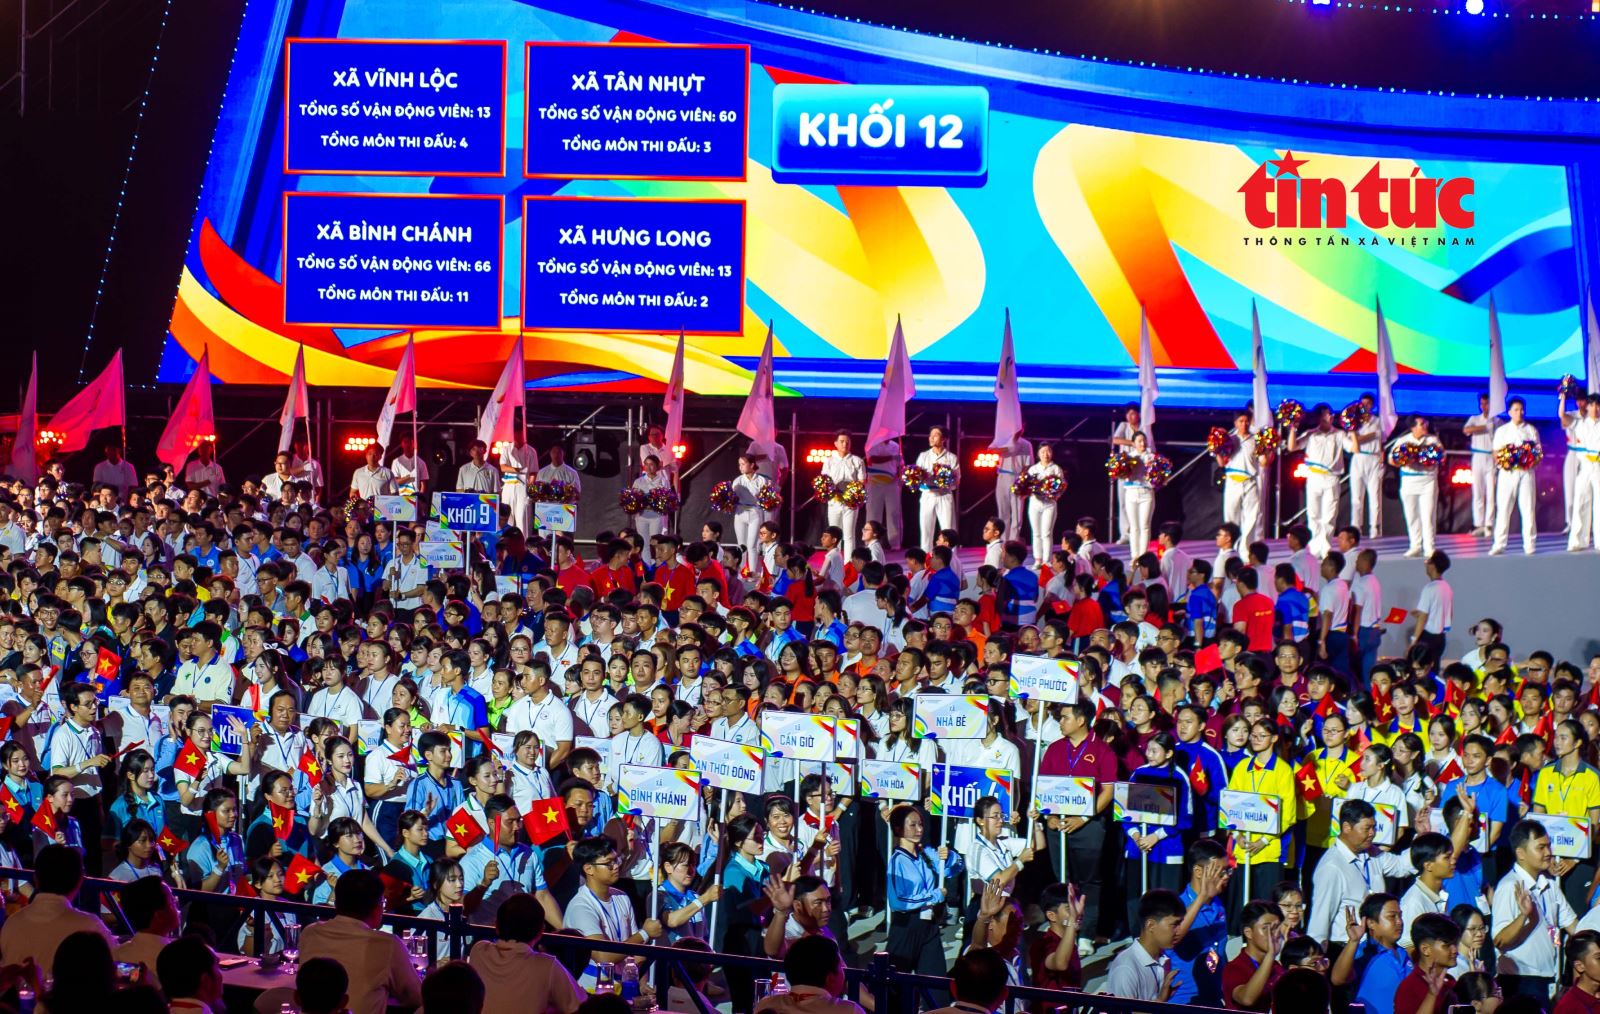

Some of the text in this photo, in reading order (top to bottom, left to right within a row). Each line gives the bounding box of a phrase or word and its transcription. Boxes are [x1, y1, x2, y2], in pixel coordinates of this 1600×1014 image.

[333, 67, 458, 92] XÃ VĨNH LỘC
[572, 71, 705, 96] XÃ TÂN NHỰT
[299, 100, 491, 119] TỔNG SỐ VẬN ĐỘNG VIÊN: 13
[538, 103, 737, 123] TỔNG SỐ VẬN ĐỘNG VIÊN: 60
[799, 98, 964, 149] KHỐI 12
[320, 130, 469, 148] TỔNG MÔN THI ĐẤU: 4
[562, 134, 712, 152] TỔNG MÔN THI ĐẤU: 3
[317, 220, 472, 242] XÃ BÌNH CHÁNH
[559, 225, 711, 248] XÃ HƯNG LONG
[297, 253, 491, 273] TỔNG SỐ VẬN ĐỘNG VIÊN: 66
[537, 257, 732, 278] TỔNG SỐ VẬN ĐỘNG VIÊN: 13
[317, 284, 469, 302] TỔNG MÔN THI ĐẤU: 11
[560, 288, 709, 307] TỔNG MÔN THI ĐẤU: 2
[447, 503, 490, 525] KHỐI 9
[936, 714, 953, 727] NHÀ
[219, 721, 251, 745] KHI
[696, 759, 708, 771] AN
[732, 765, 756, 781] ĐÔNG
[630, 787, 687, 806] BÌNH KHÁNH
